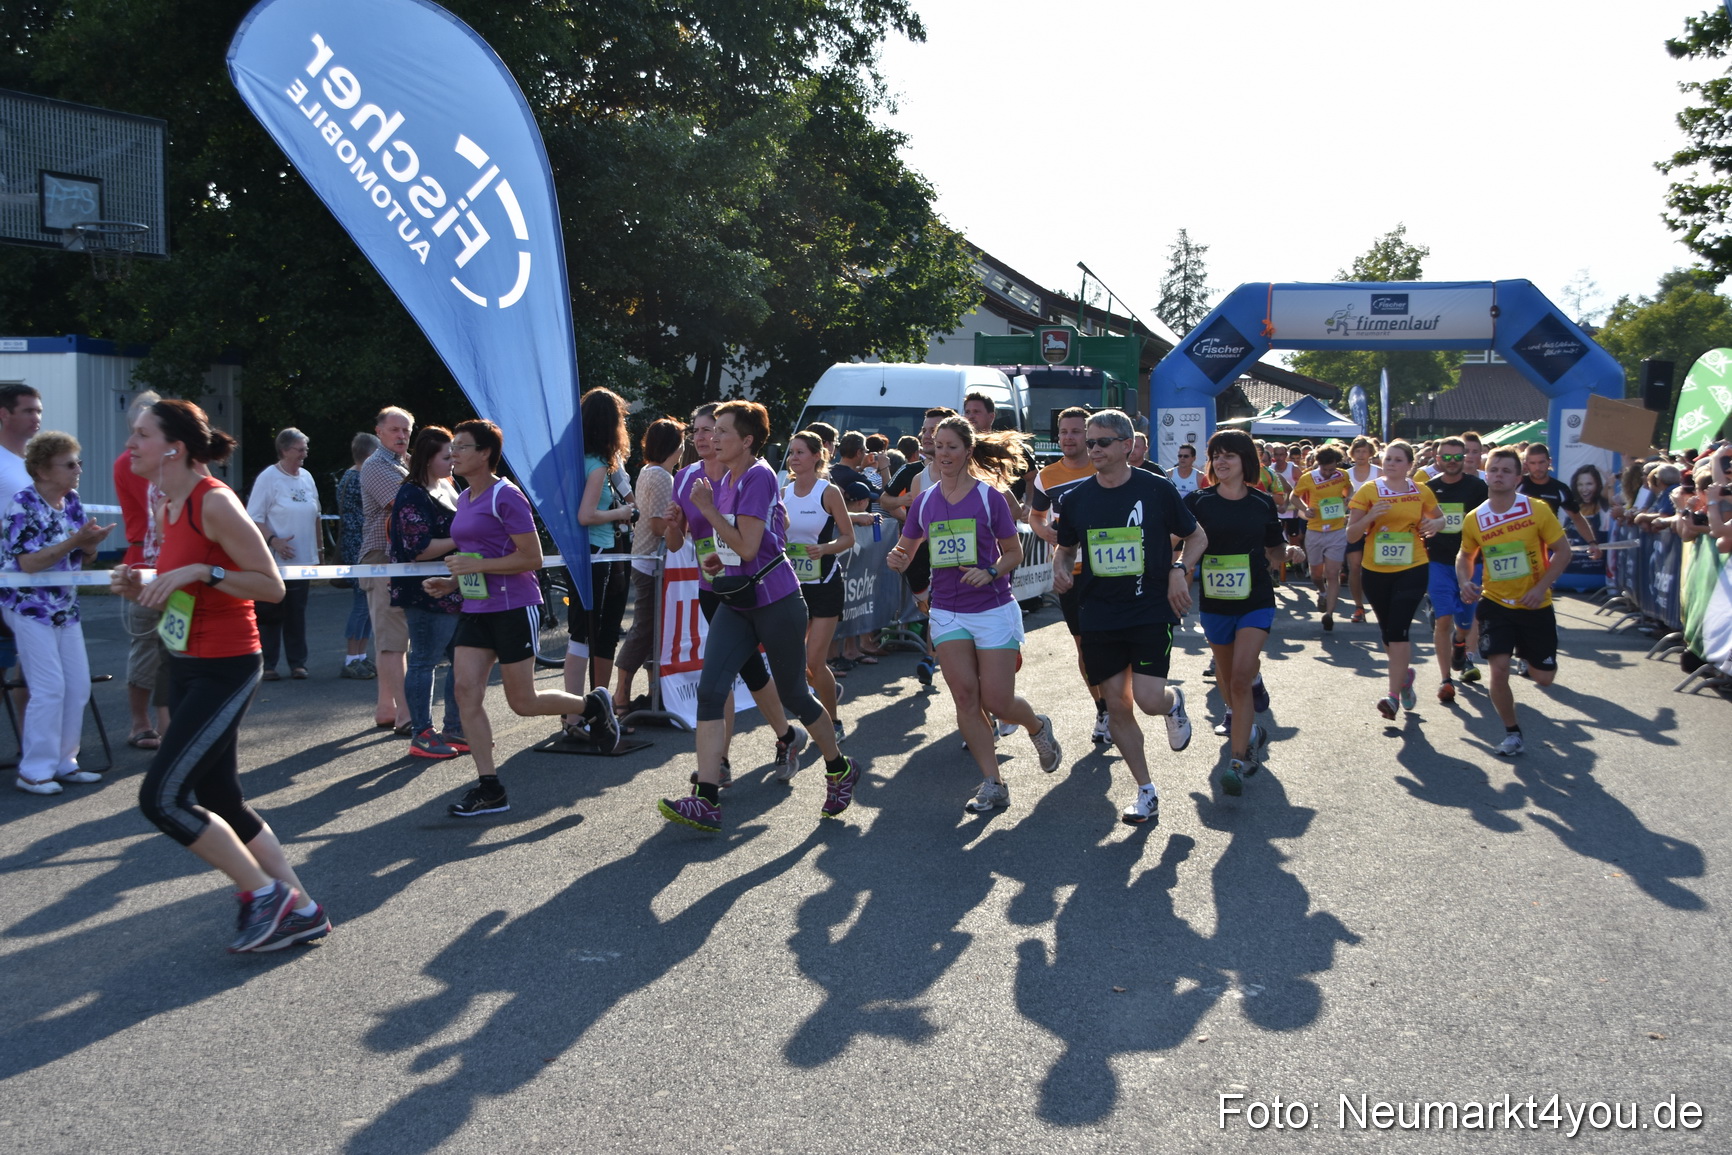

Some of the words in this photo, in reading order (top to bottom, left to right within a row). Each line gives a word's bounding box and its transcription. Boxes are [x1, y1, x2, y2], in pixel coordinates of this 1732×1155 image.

[1356, 315, 1441, 331] firmenlauf
[1201, 345, 1245, 354] Fischer
[1676, 405, 1710, 437] AOK
[1324, 505, 1340, 515] 937
[1446, 515, 1461, 525] 85
[1481, 528, 1504, 542] MAX
[1507, 519, 1535, 533] BÖGL
[938, 537, 967, 555] 293
[1381, 545, 1406, 557] 897
[1094, 546, 1136, 564] 1141
[790, 558, 813, 572] 976
[1492, 557, 1518, 572] 877
[463, 572, 481, 587] 302
[1206, 572, 1246, 588] 1237
